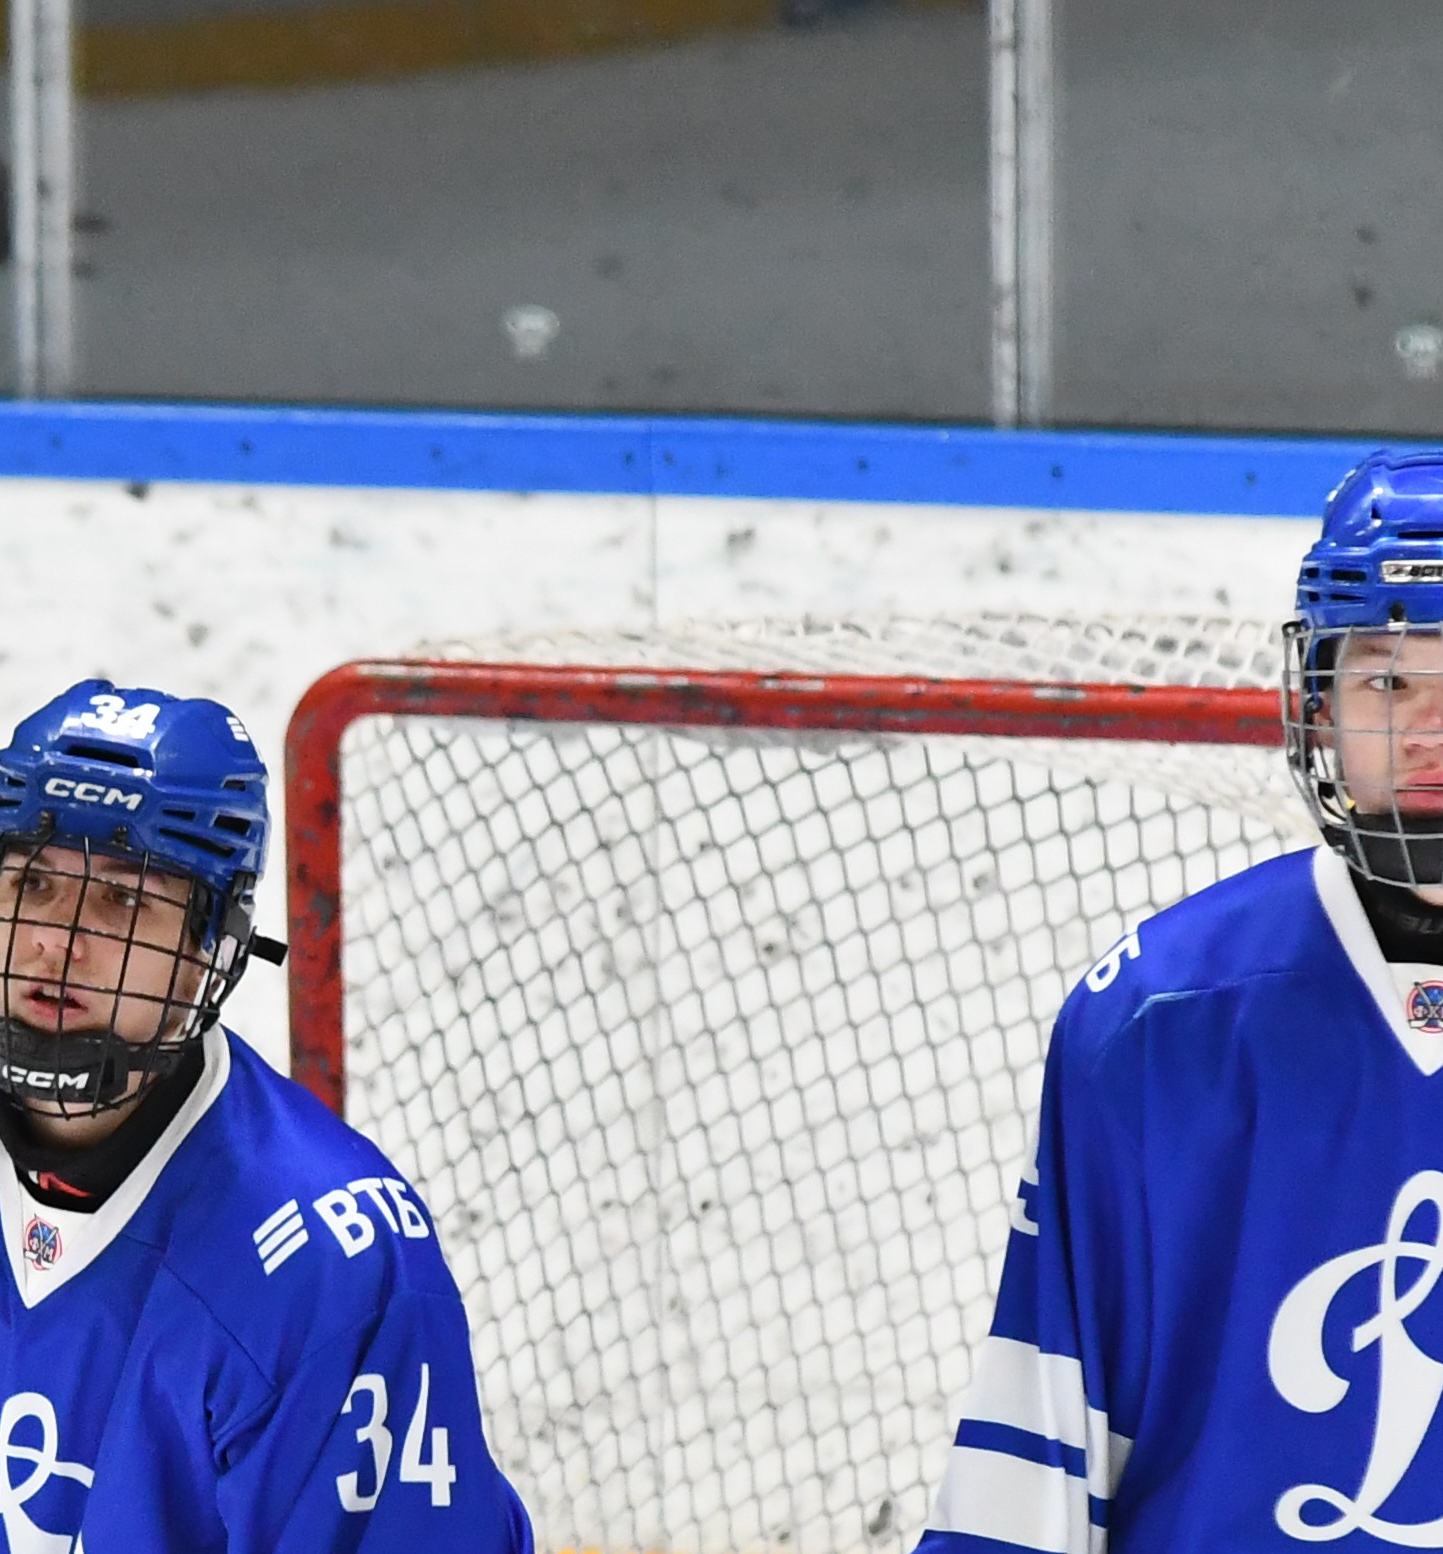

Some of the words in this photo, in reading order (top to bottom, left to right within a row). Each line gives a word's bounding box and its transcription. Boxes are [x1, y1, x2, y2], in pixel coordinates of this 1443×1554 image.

[89, 694, 161, 740] 34
[44, 777, 144, 812] CCM
[1, 1064, 90, 1090] CCM
[312, 1178, 429, 1259] ВТБ
[335, 1362, 458, 1514] 34
